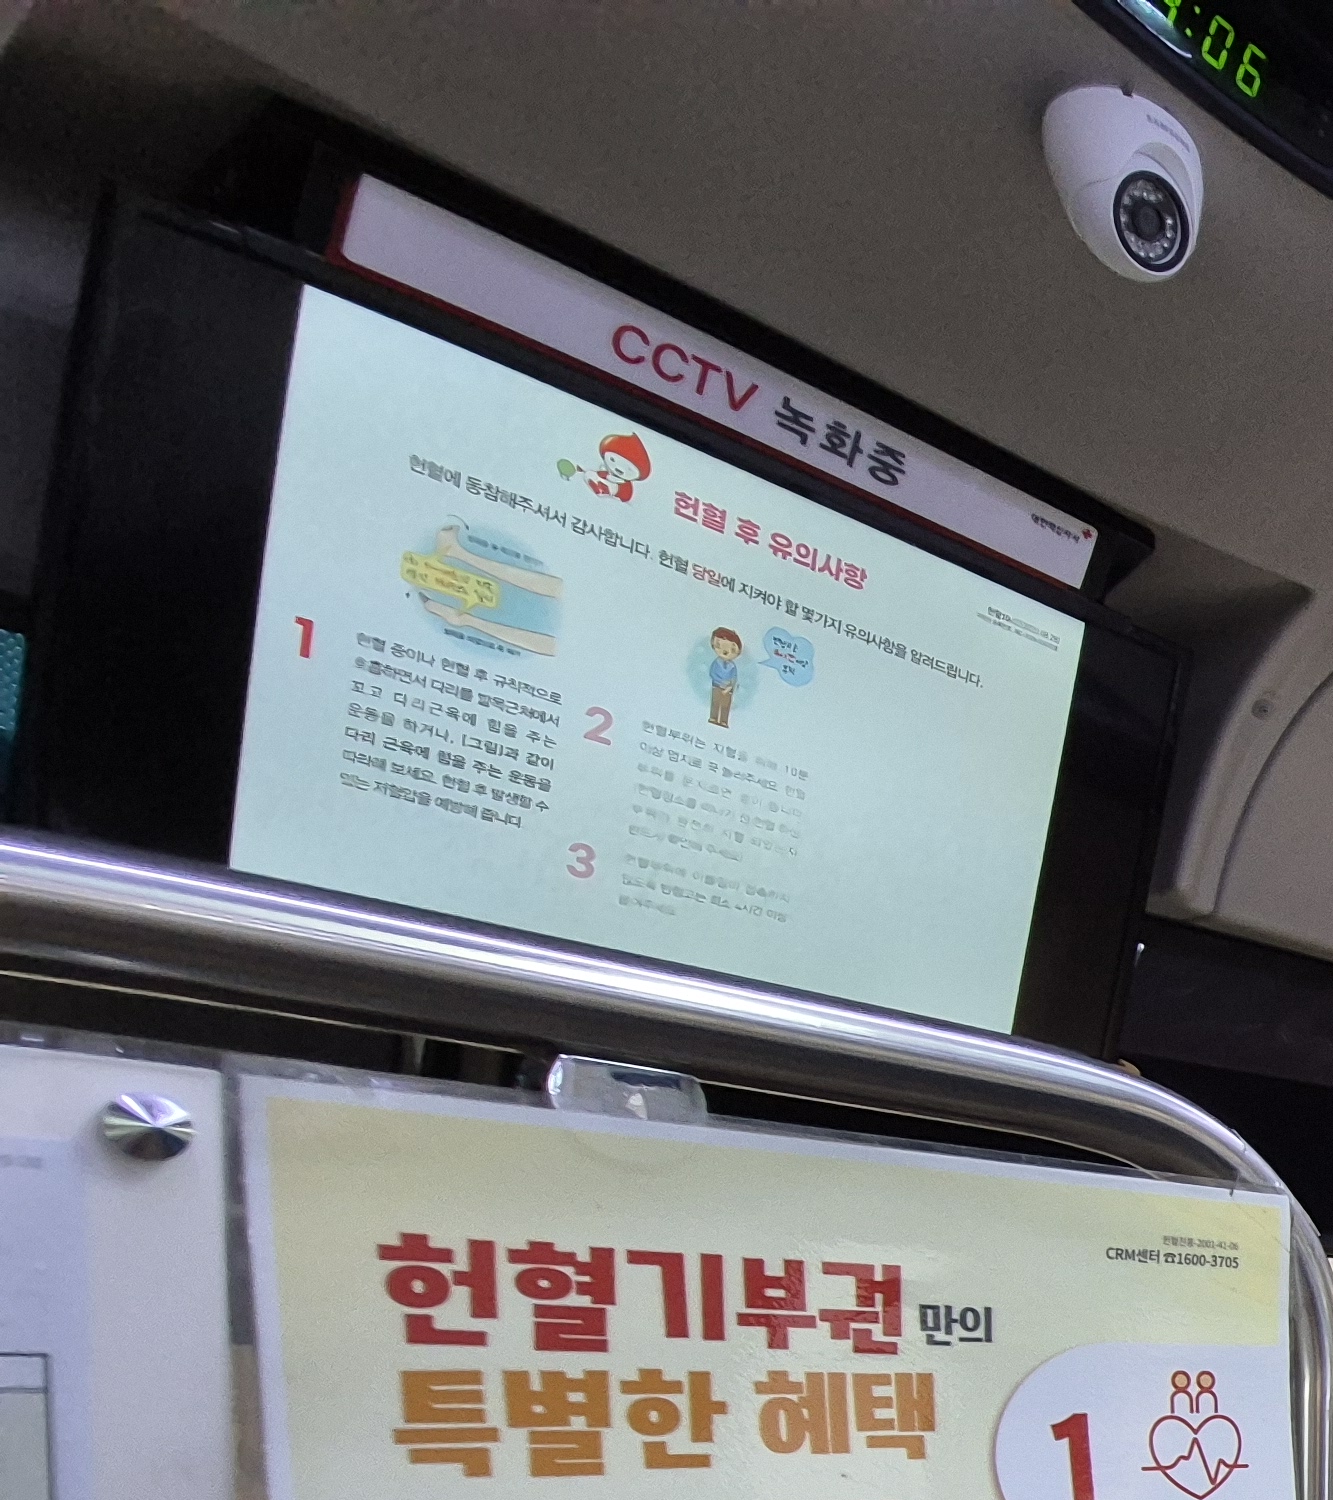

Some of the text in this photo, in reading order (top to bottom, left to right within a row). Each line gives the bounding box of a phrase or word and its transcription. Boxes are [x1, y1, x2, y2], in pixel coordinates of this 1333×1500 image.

[610, 324, 909, 488] CCTV 녹화중
[409, 454, 461, 489] 헌혈에
[465, 476, 568, 528] 동참해주셔서
[570, 516, 653, 560] 감사합니다.
[657, 549, 690, 575] 헌혈
[691, 562, 736, 593] 당일에
[738, 581, 783, 611] 지켜야
[801, 603, 842, 635] 몇가지
[842, 623, 908, 660] 유의사항을
[910, 648, 985, 689] 알려드립니다.
[674, 490, 868, 591] 헌혈 후 유의사항
[294, 615, 315, 659] 1
[583, 706, 614, 746] 2
[566, 842, 597, 879] 3
[376, 1230, 996, 1356] 헌혈기부권 만의
[1105, 1247, 1161, 1265] CRM센터
[392, 1368, 938, 1480] 특별한 혜택
